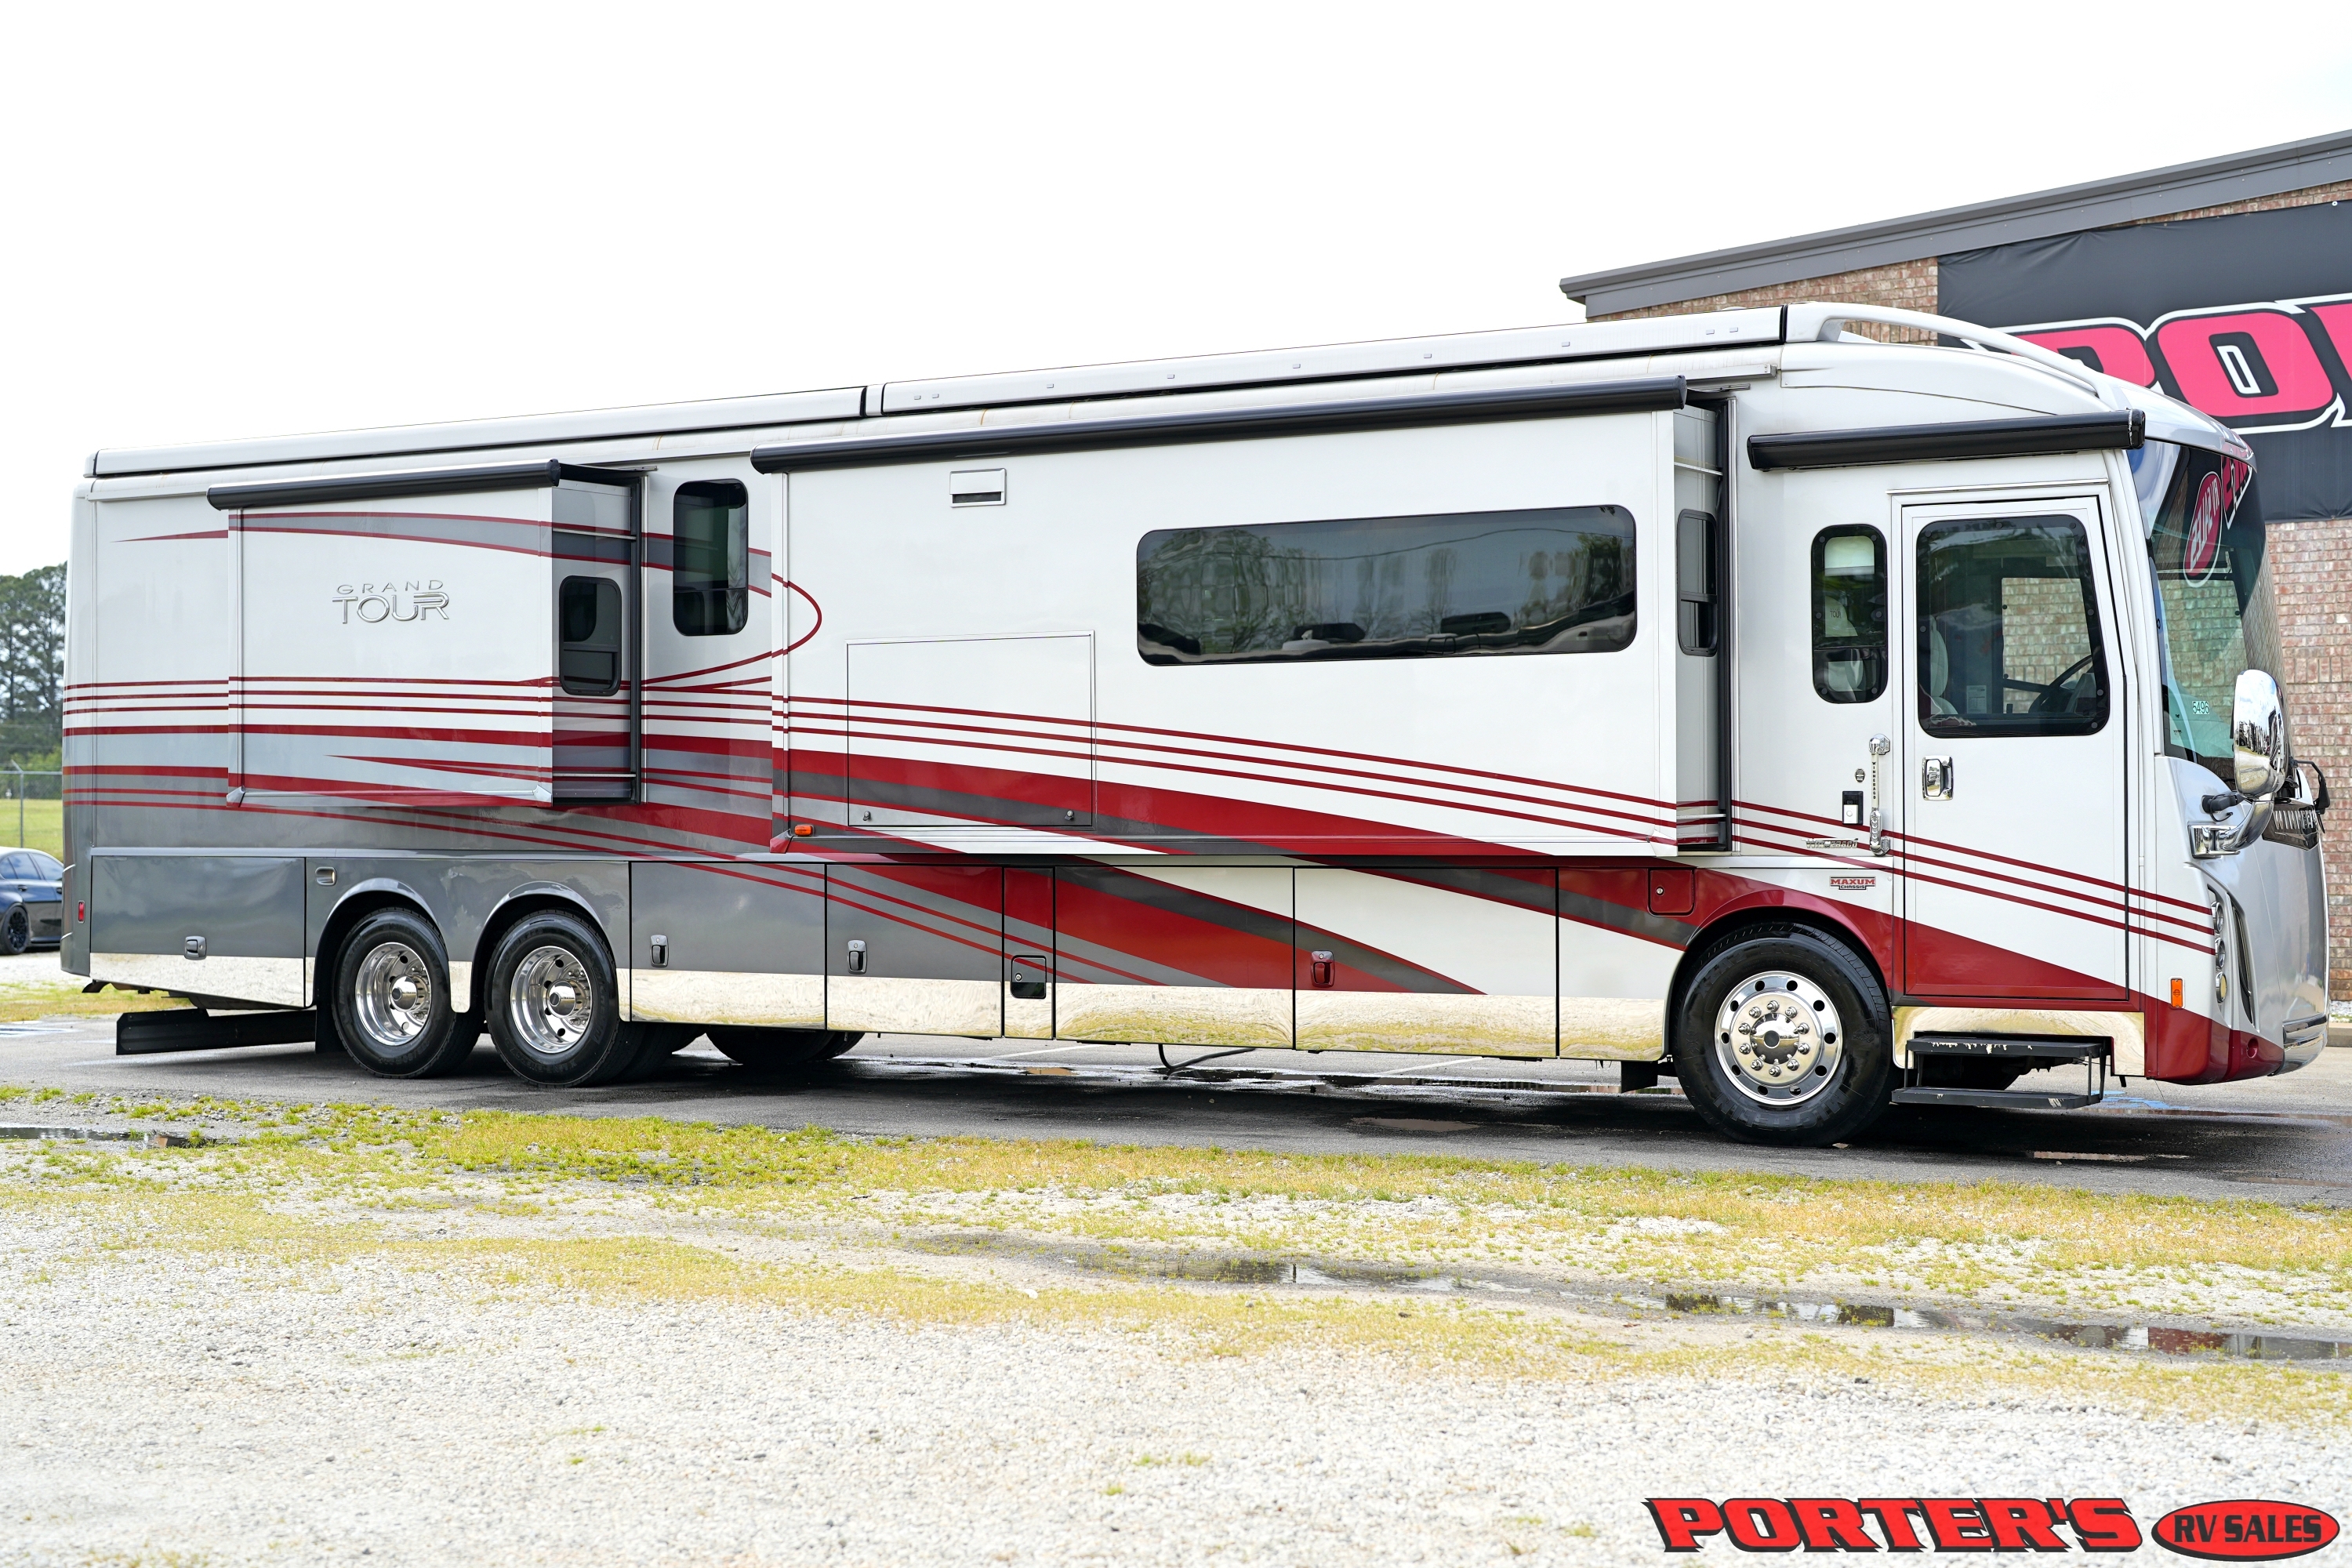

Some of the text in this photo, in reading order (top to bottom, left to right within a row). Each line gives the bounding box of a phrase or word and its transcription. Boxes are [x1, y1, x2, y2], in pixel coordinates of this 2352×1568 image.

[336, 580, 443, 595] GRAND
[332, 592, 449, 624] TOUR
[2193, 701, 2209, 714] 5496
[1711, 1088, 1851, 1132] MICHELIN
